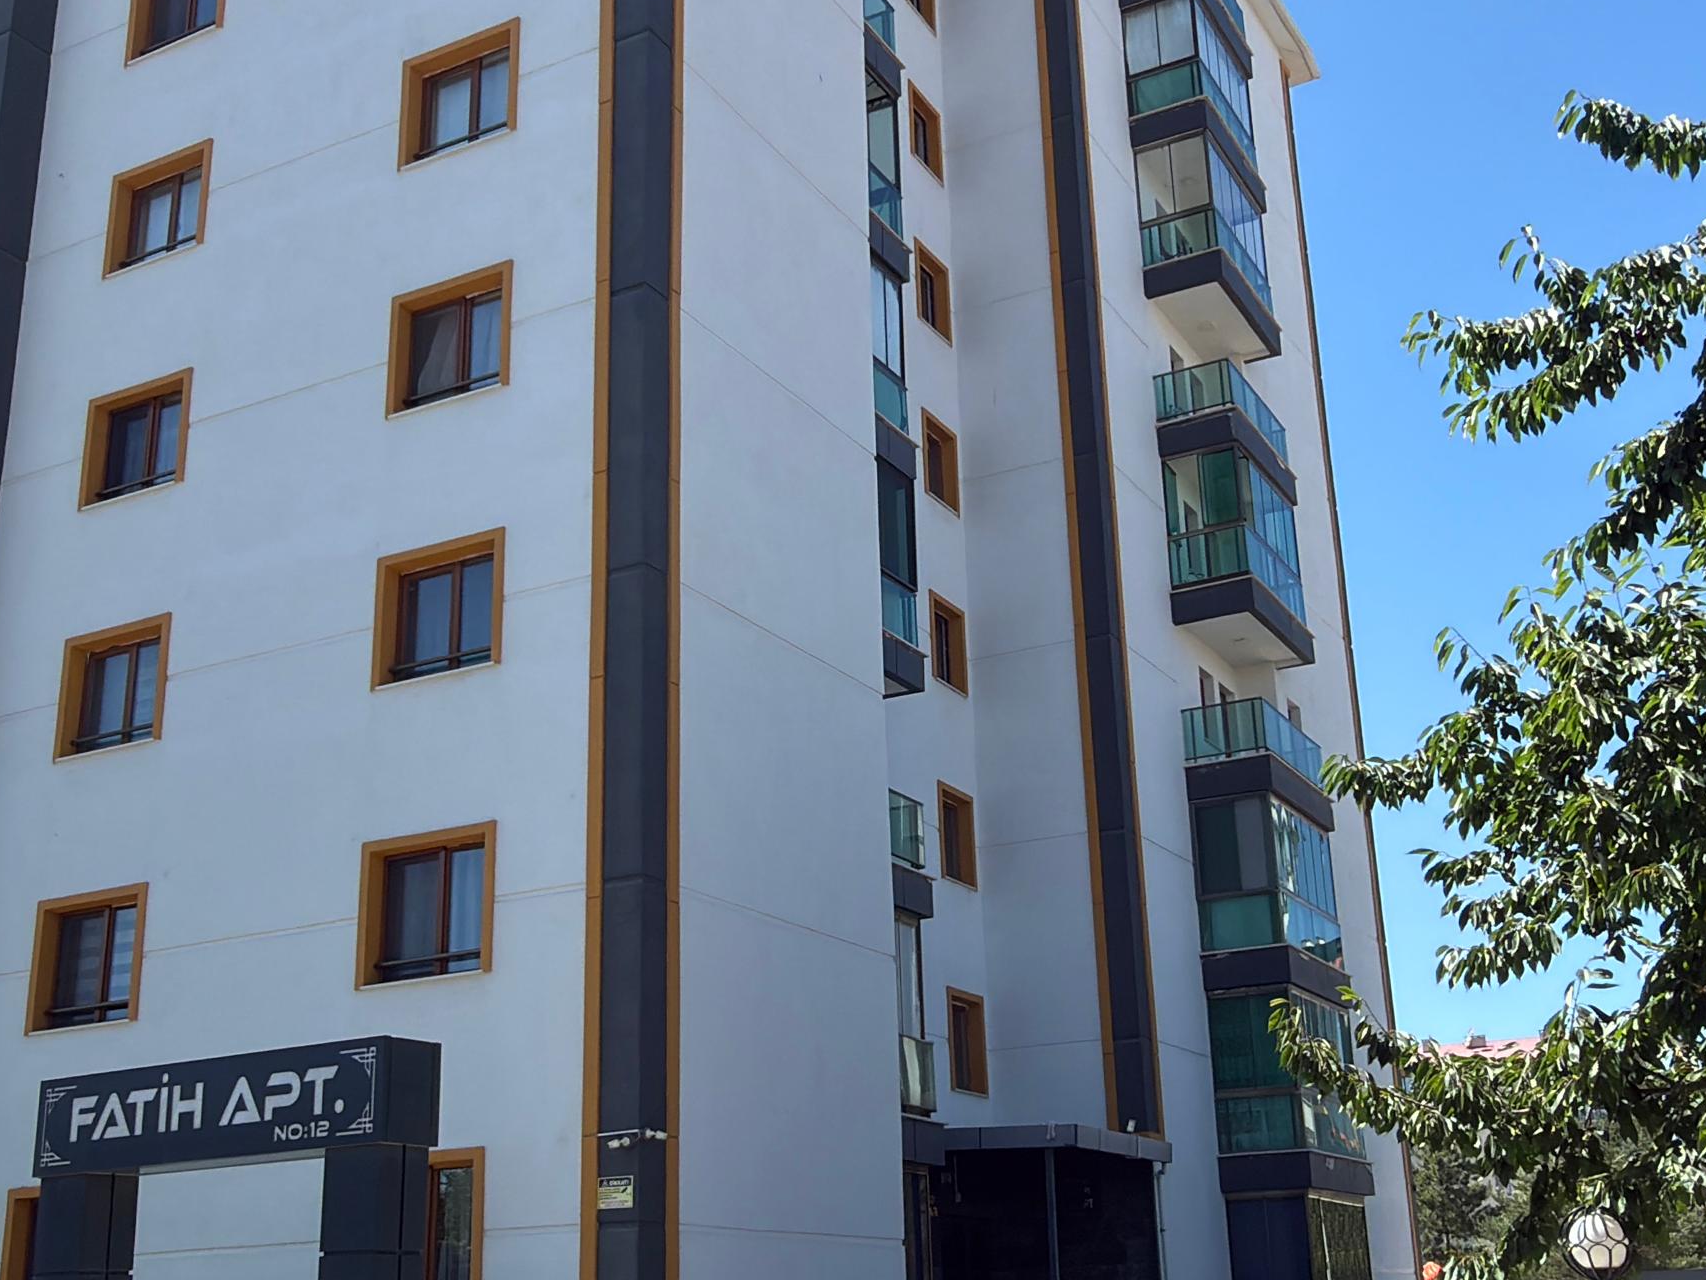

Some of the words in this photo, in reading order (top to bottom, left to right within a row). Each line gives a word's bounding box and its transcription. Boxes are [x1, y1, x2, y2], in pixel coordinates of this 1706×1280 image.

[69, 1072, 204, 1143] FATİH
[218, 1065, 345, 1126] APT.
[273, 1120, 330, 1142] NO:12
